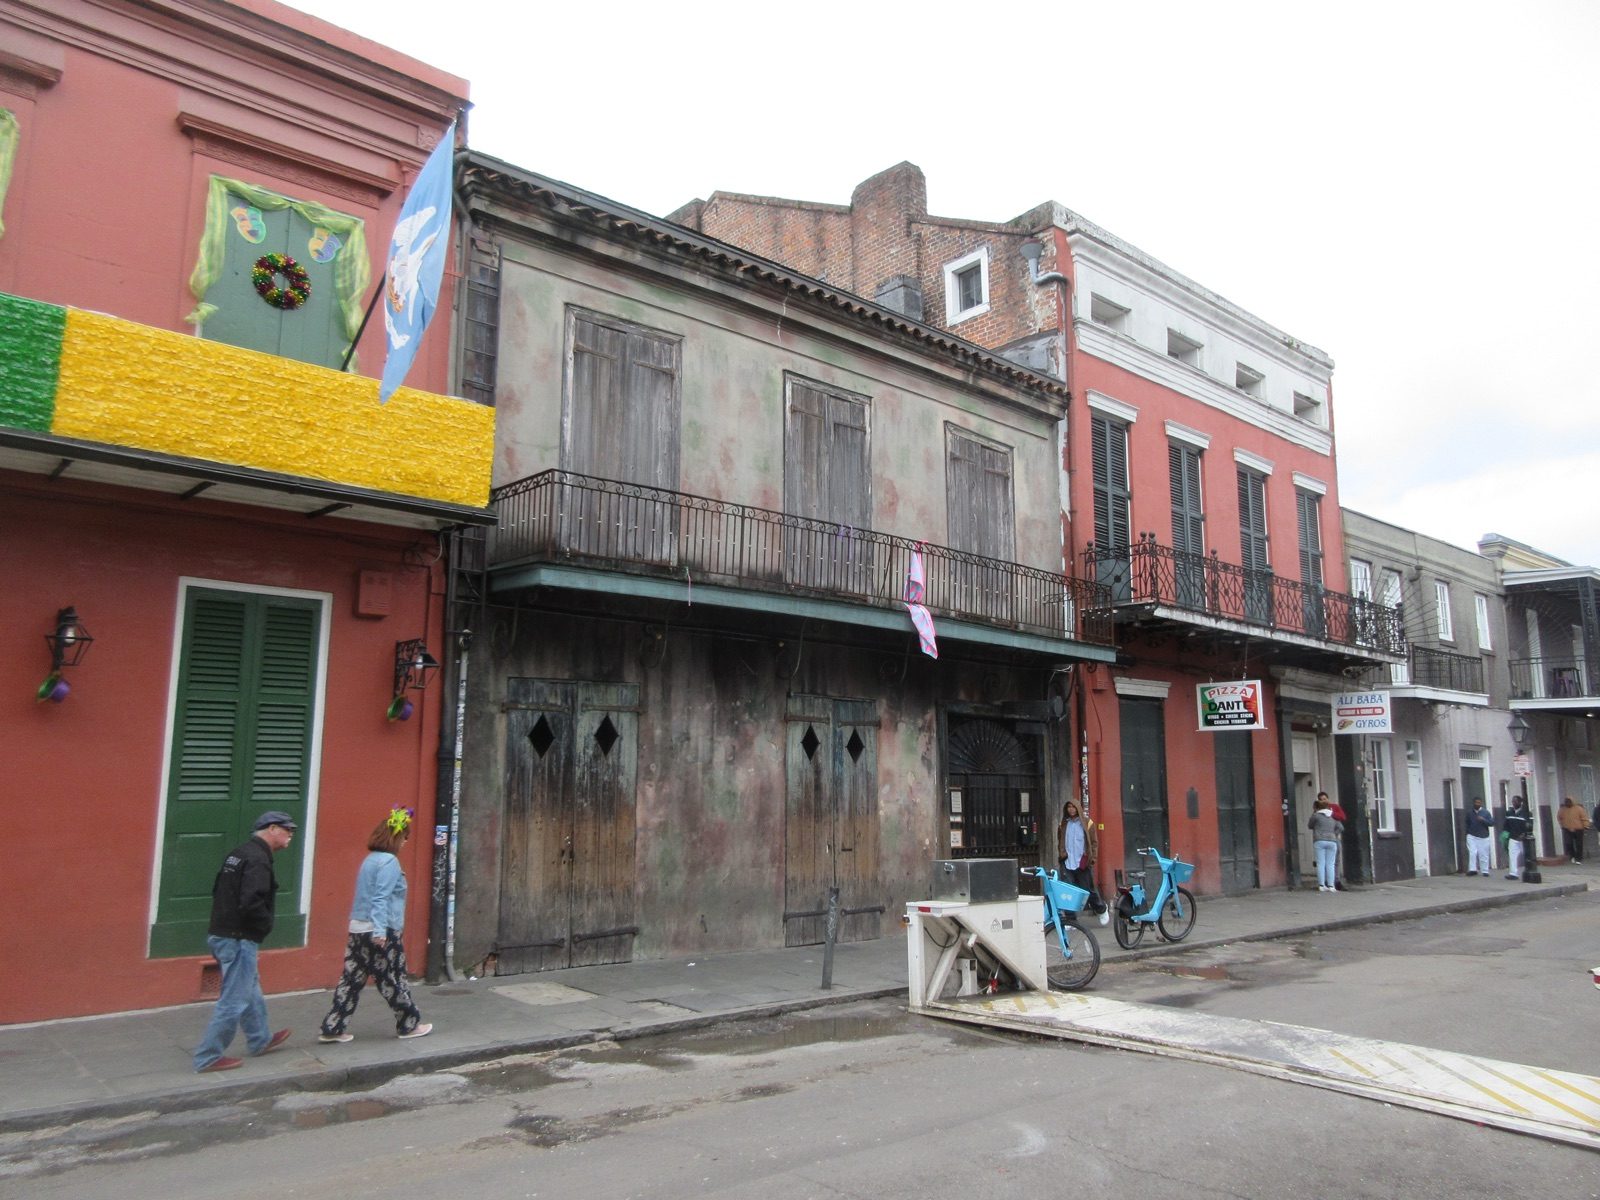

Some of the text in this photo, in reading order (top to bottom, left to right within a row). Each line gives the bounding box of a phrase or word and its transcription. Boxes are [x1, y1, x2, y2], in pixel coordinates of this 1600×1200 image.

[1208, 686, 1248, 698] PIZZA
[1337, 694, 1383, 705] ALI BABA
[1208, 700, 1252, 712] DANTE
[1355, 719, 1387, 728] GYROS
